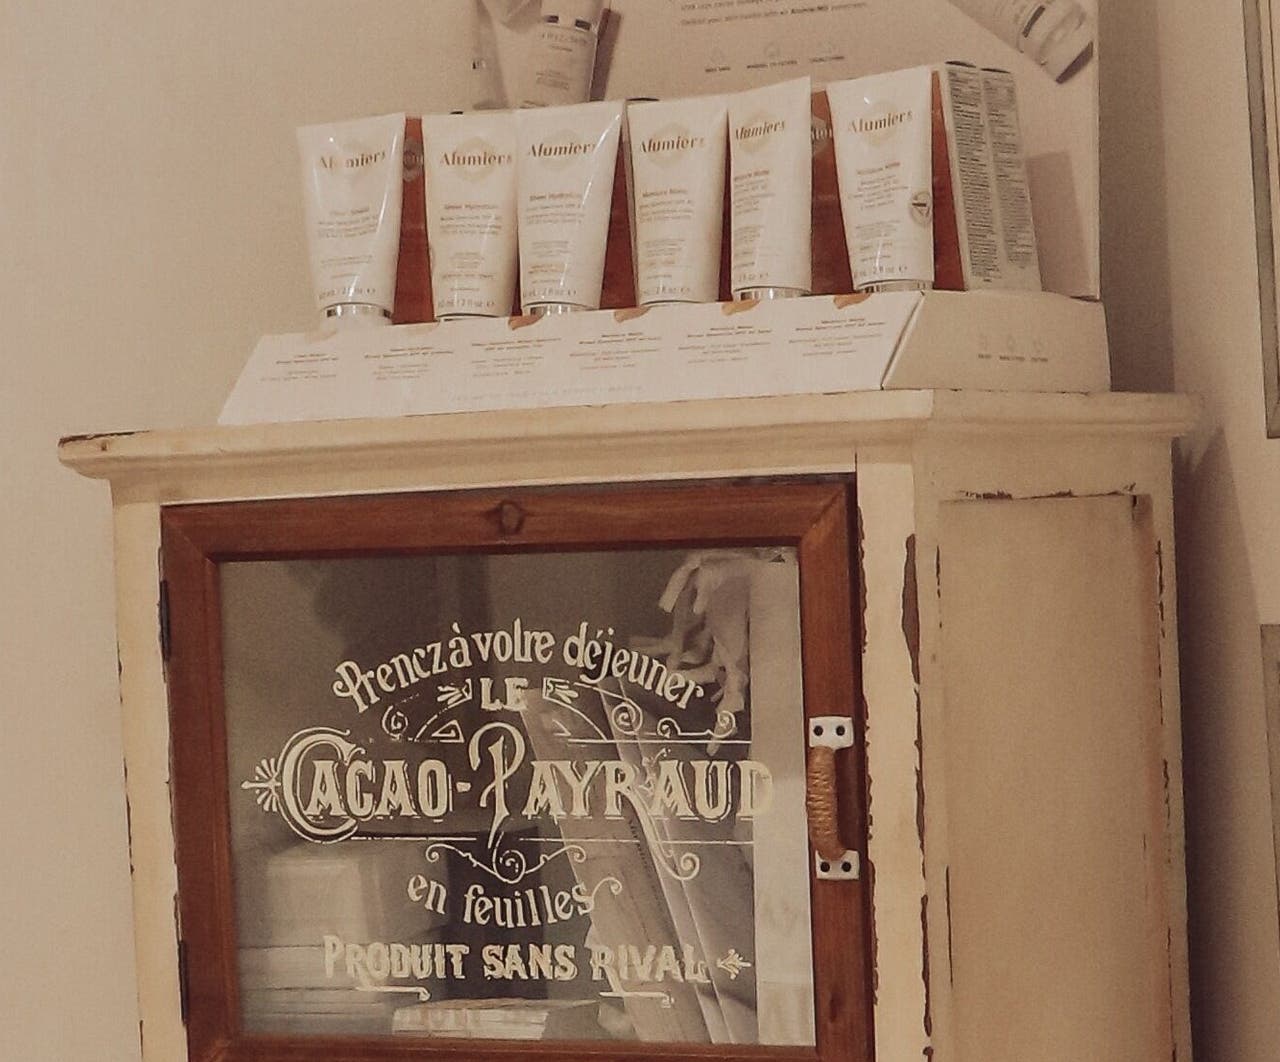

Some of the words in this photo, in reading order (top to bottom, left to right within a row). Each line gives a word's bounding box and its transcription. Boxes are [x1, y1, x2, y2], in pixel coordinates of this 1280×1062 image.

[479, 677, 529, 712] LE
[406, 873, 448, 915] en
[462, 880, 598, 928] feuilles
[322, 934, 470, 981] PRODUIT
[481, 942, 577, 981] SANS
[589, 943, 712, 983] RIVAL
